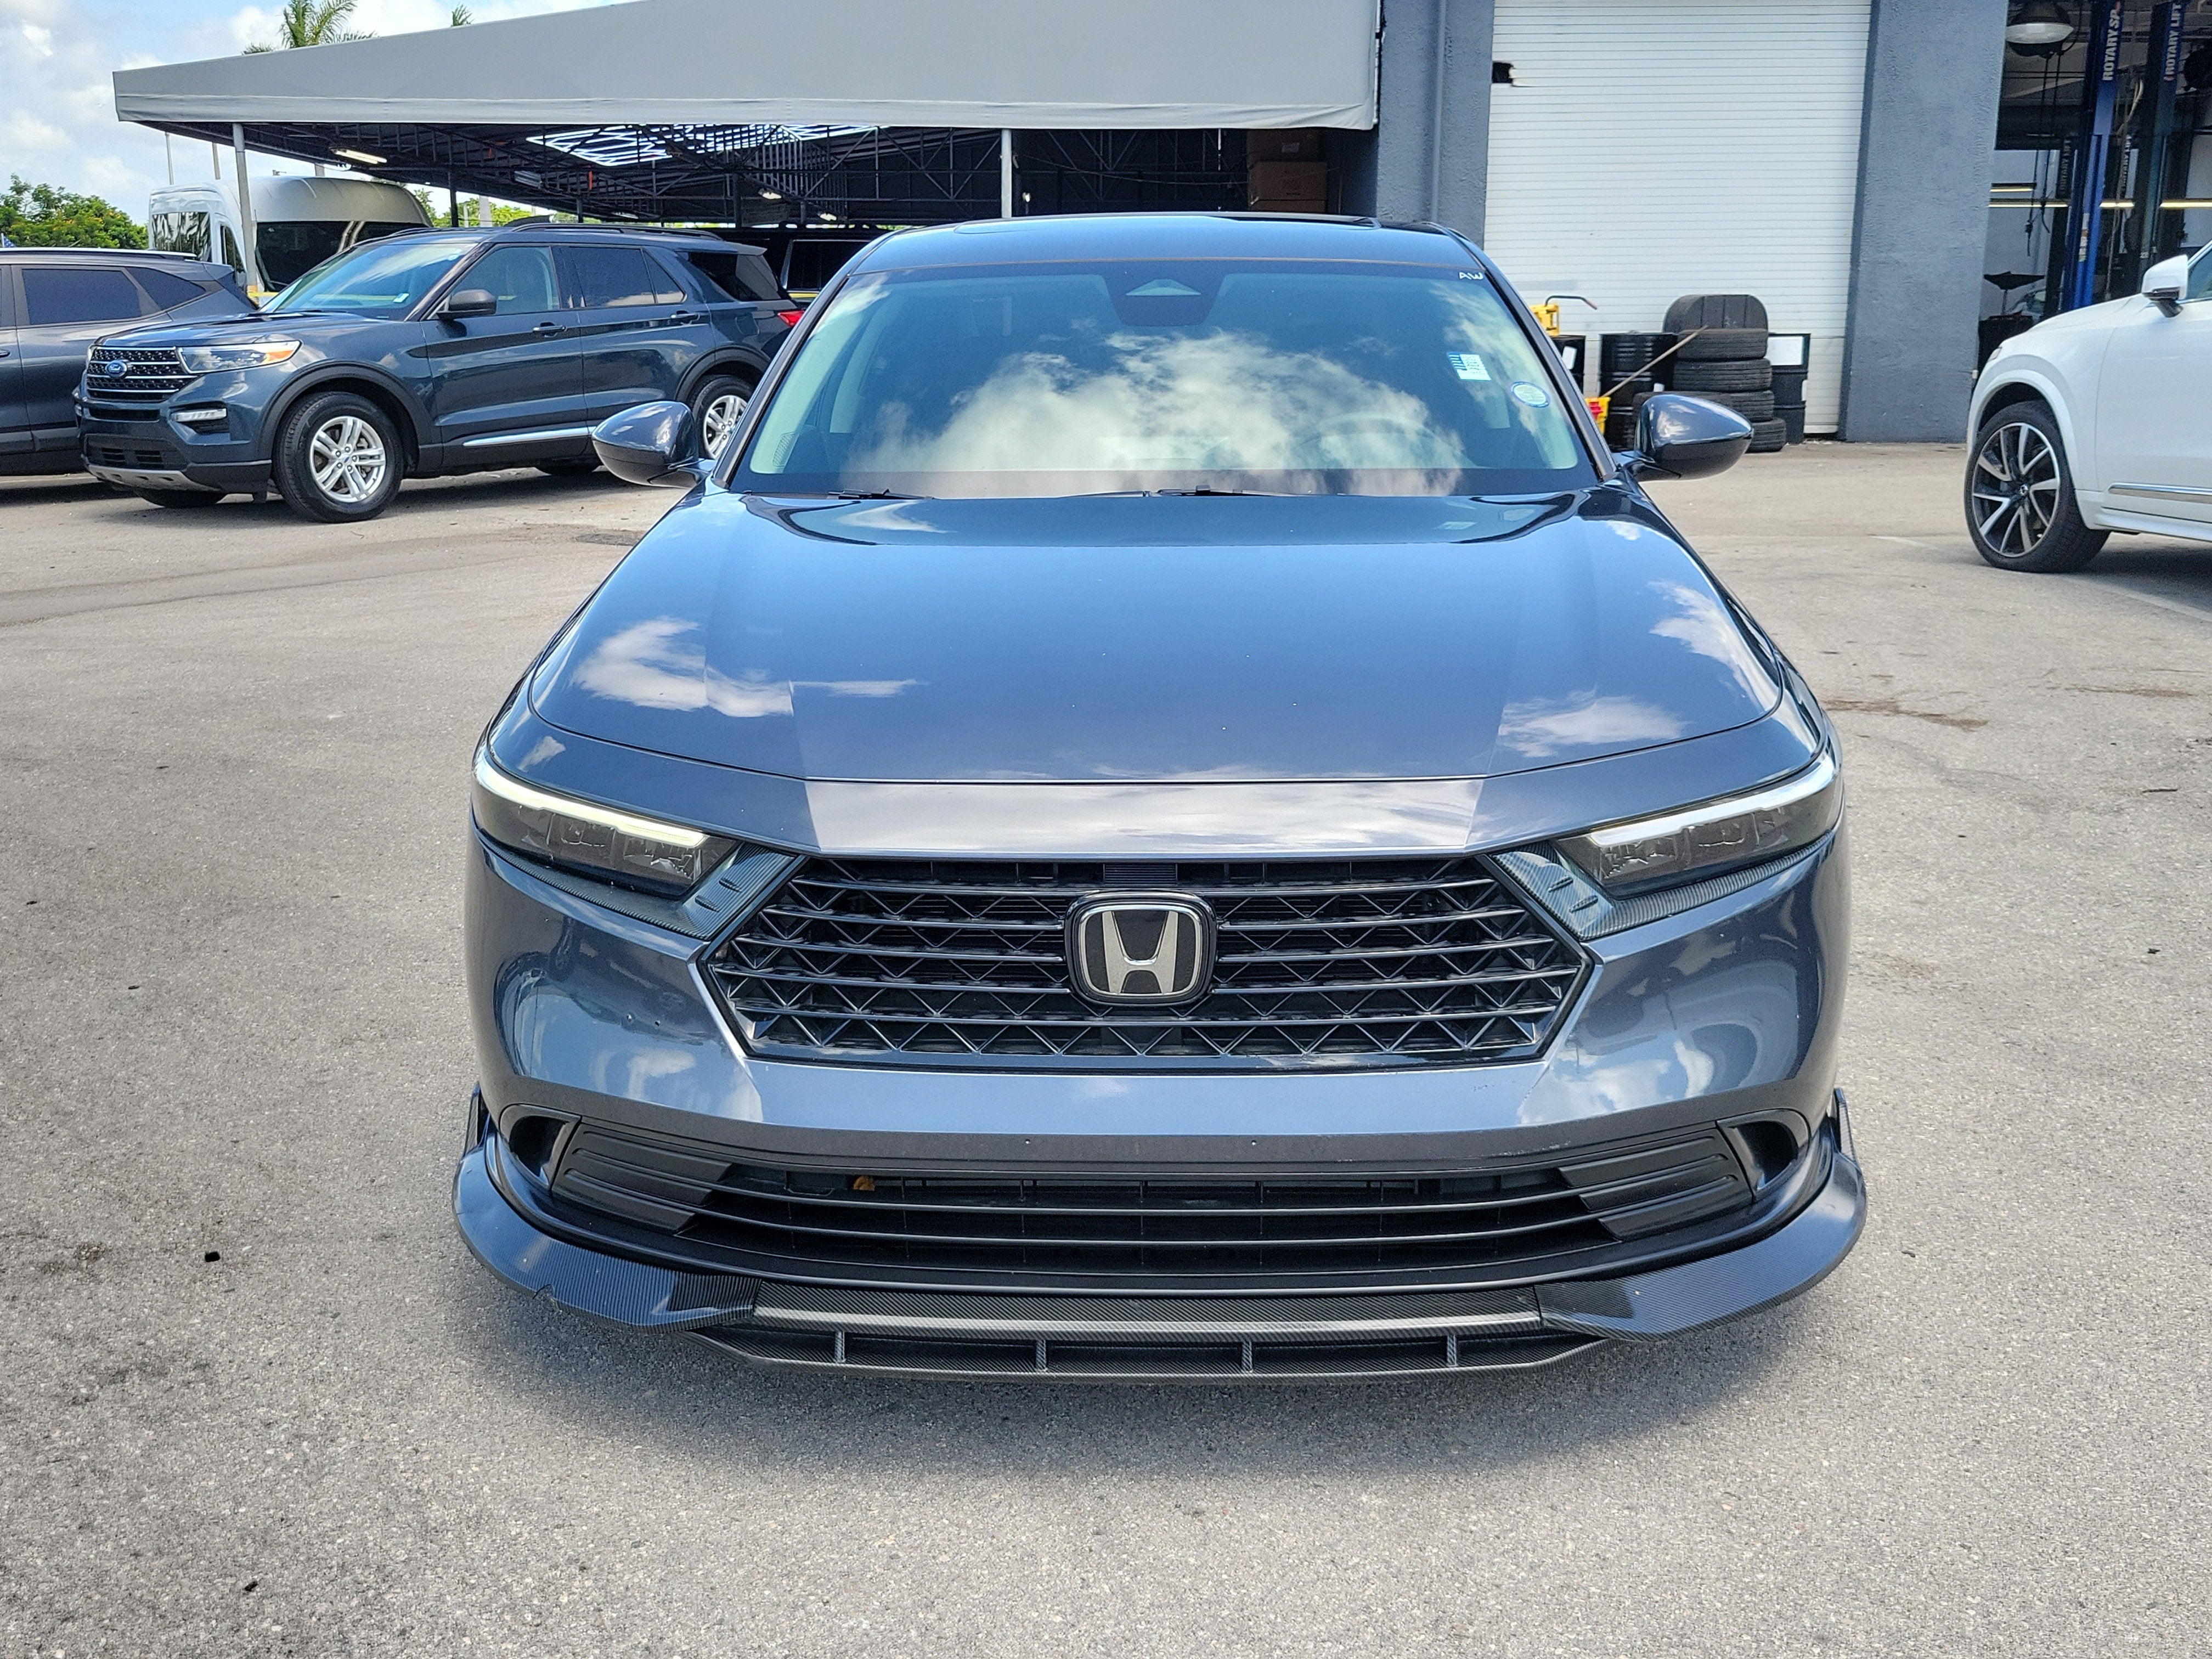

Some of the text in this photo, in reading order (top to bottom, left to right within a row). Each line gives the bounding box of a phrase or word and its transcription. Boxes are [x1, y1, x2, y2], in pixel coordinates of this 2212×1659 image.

[2102, 29, 2118, 80] ROTARY
[2165, 3, 2182, 75] ROTARY LIFT
